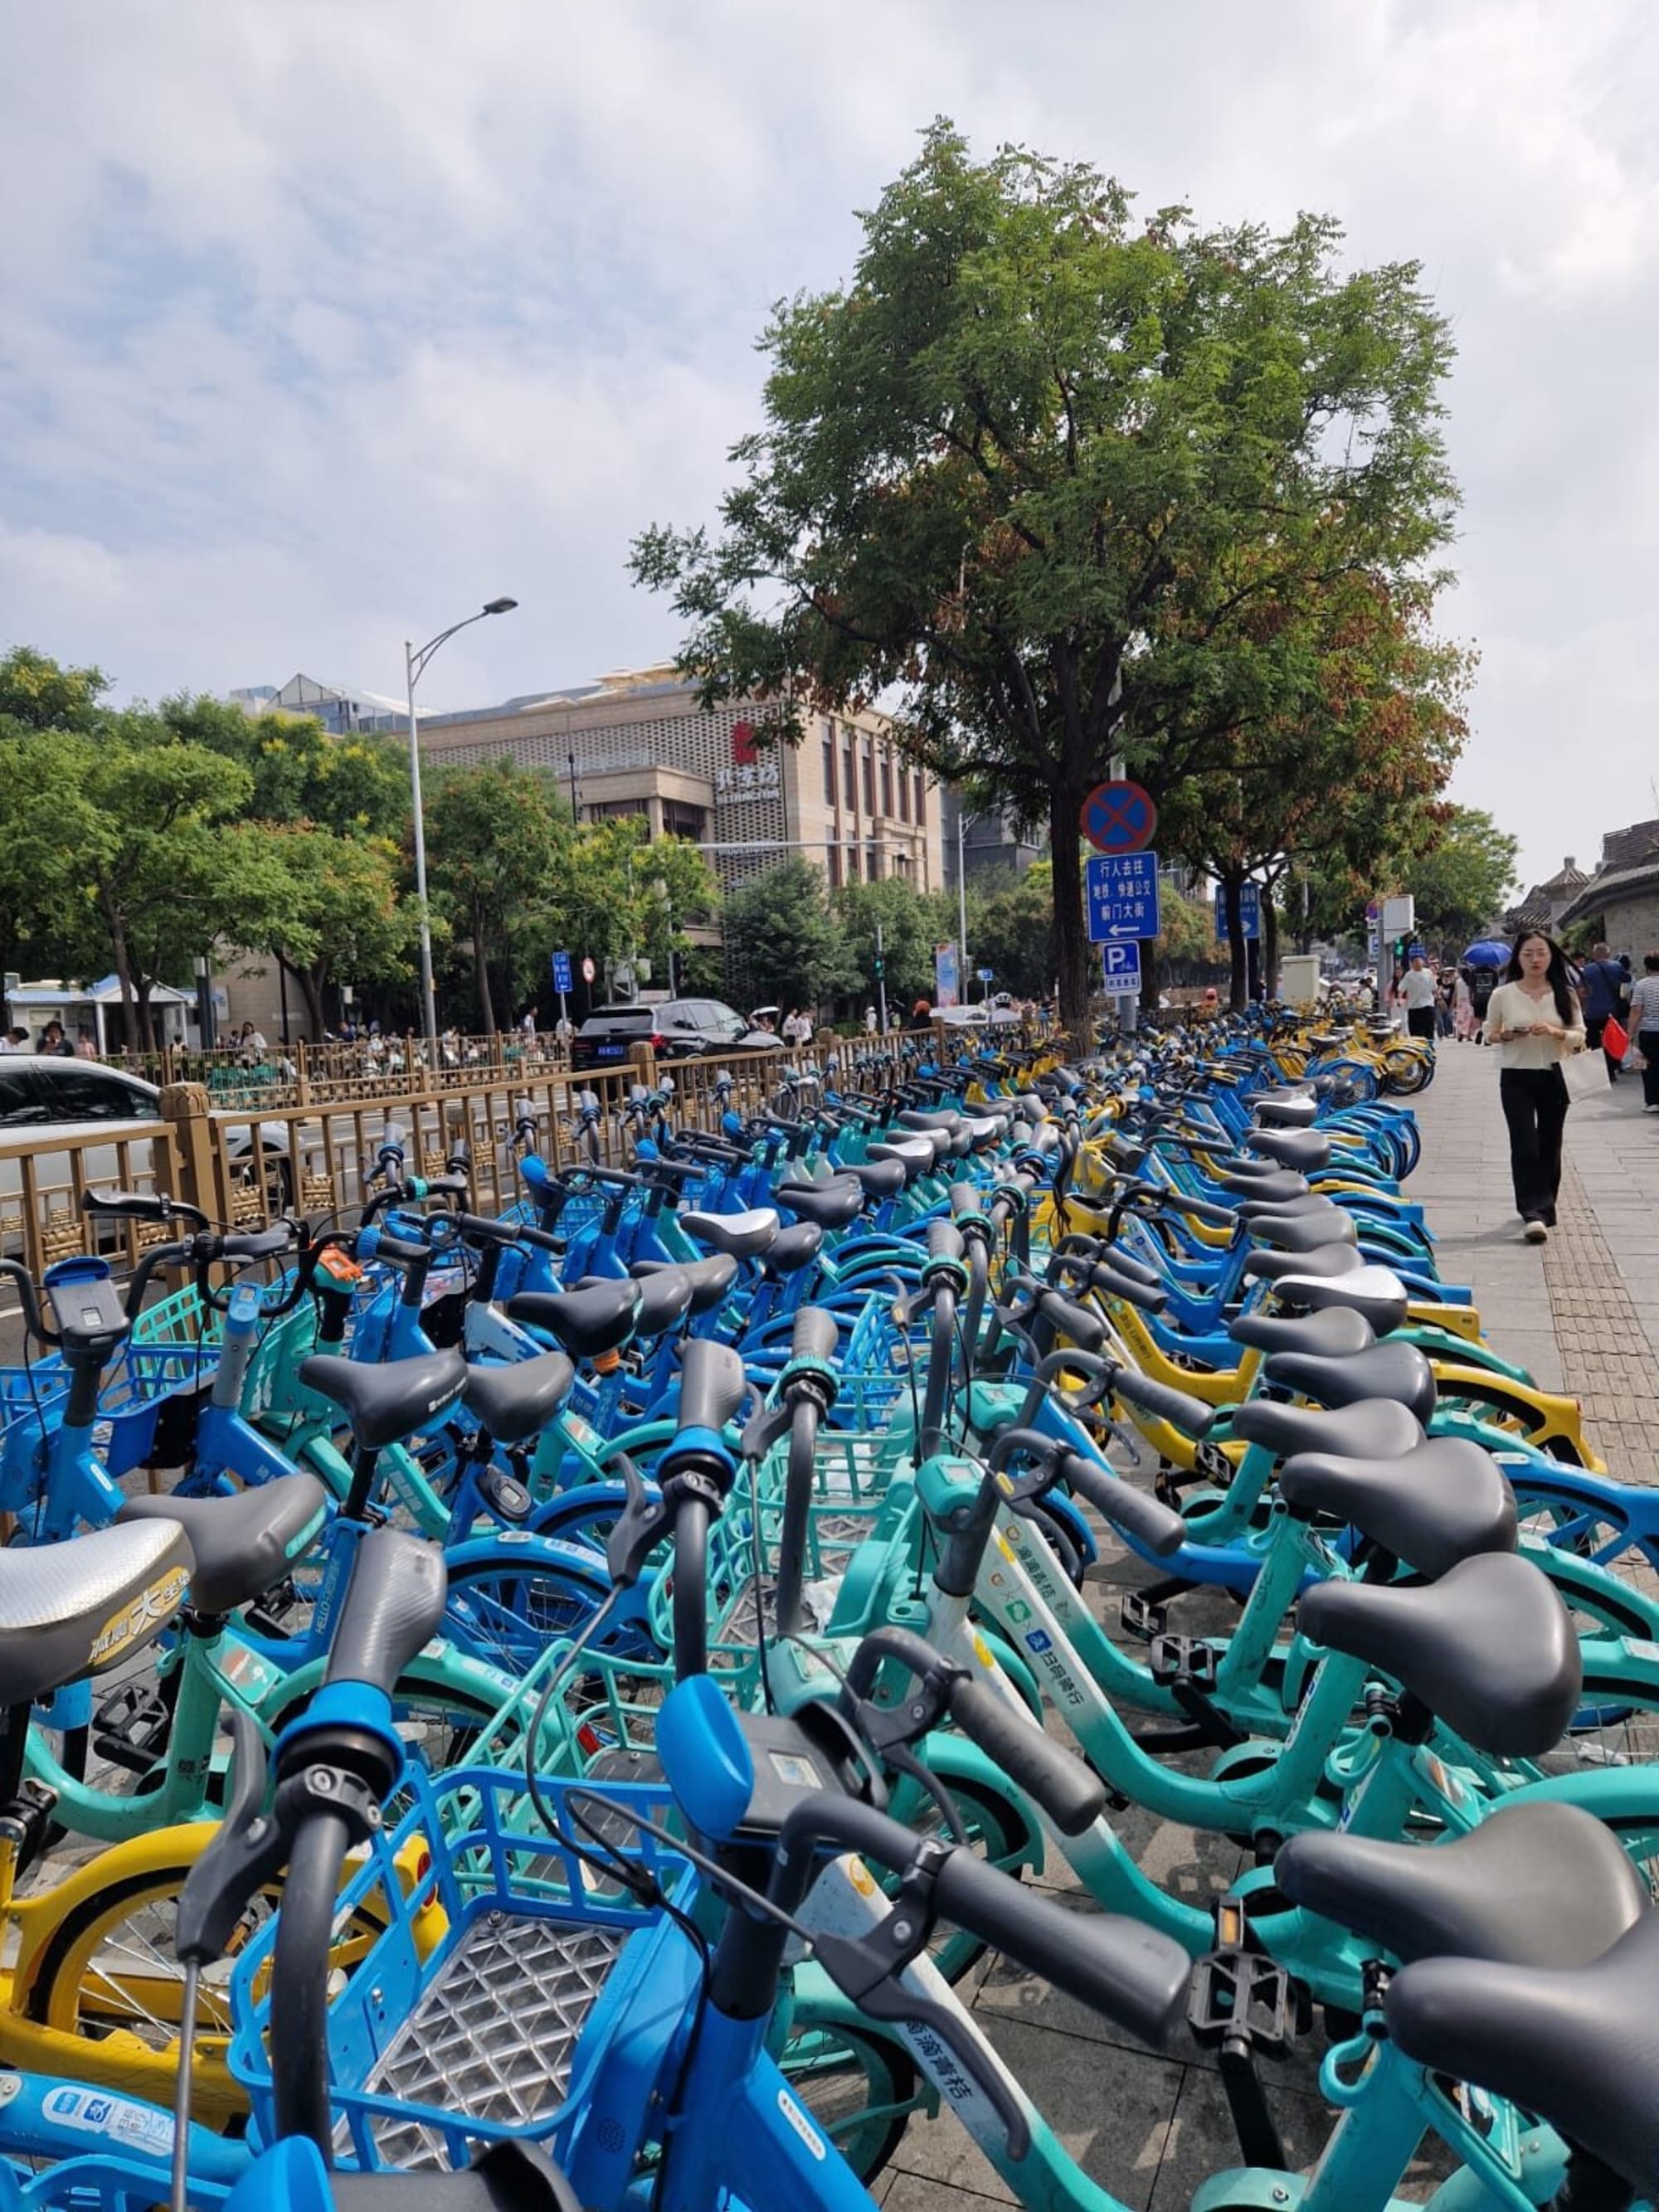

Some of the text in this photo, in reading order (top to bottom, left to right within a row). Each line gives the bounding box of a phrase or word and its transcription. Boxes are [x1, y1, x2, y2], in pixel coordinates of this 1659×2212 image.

[1100, 859, 1143, 878] 行人去往
[1101, 902, 1144, 921] 前门大街
[1108, 947, 1126, 972] P
[1040, 1651, 1085, 1705] 扫码骑行
